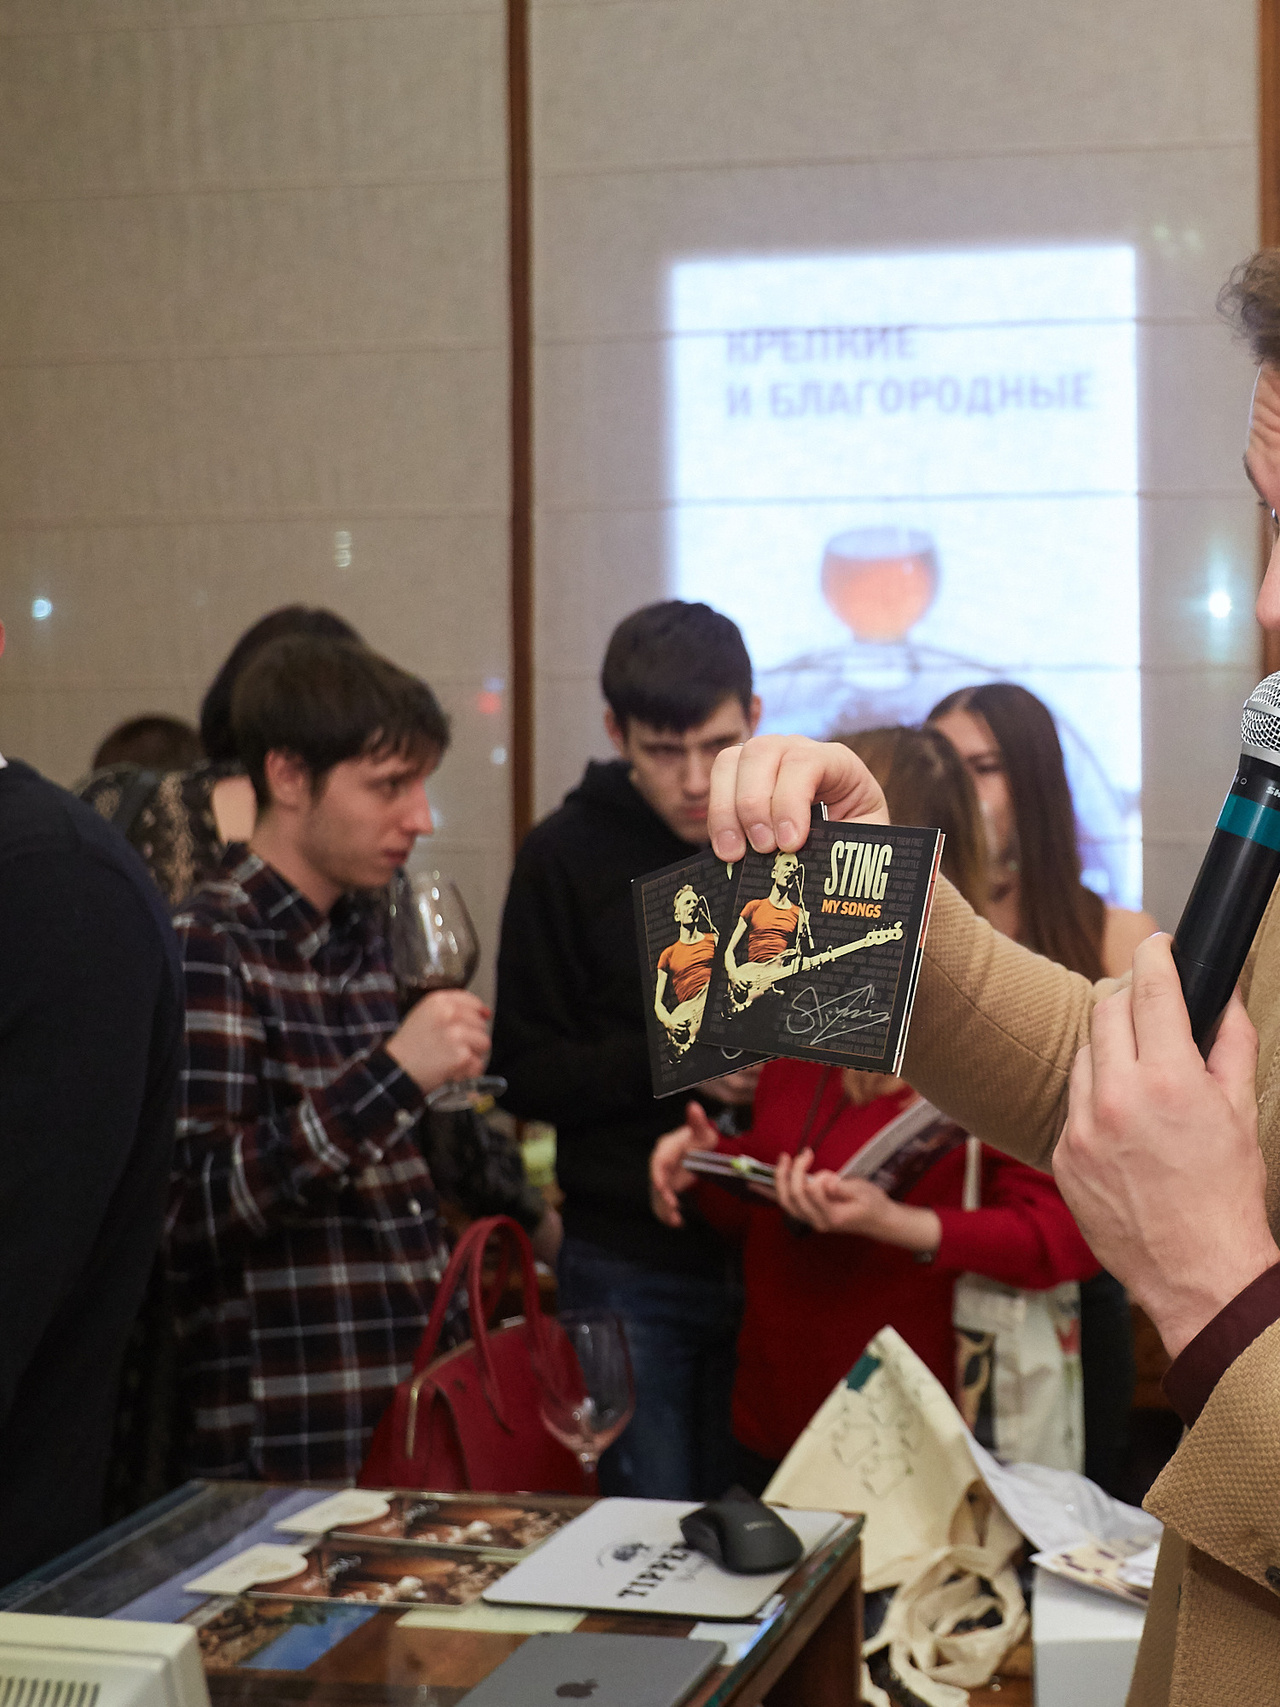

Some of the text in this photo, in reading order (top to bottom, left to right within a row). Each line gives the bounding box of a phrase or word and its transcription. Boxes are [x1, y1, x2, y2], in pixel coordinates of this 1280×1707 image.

[725, 367, 1096, 420] И БЛАГОРОДНЫЕ
[823, 840, 893, 900] STING
[821, 899, 842, 914] MY
[840, 901, 882, 919] SONGS
